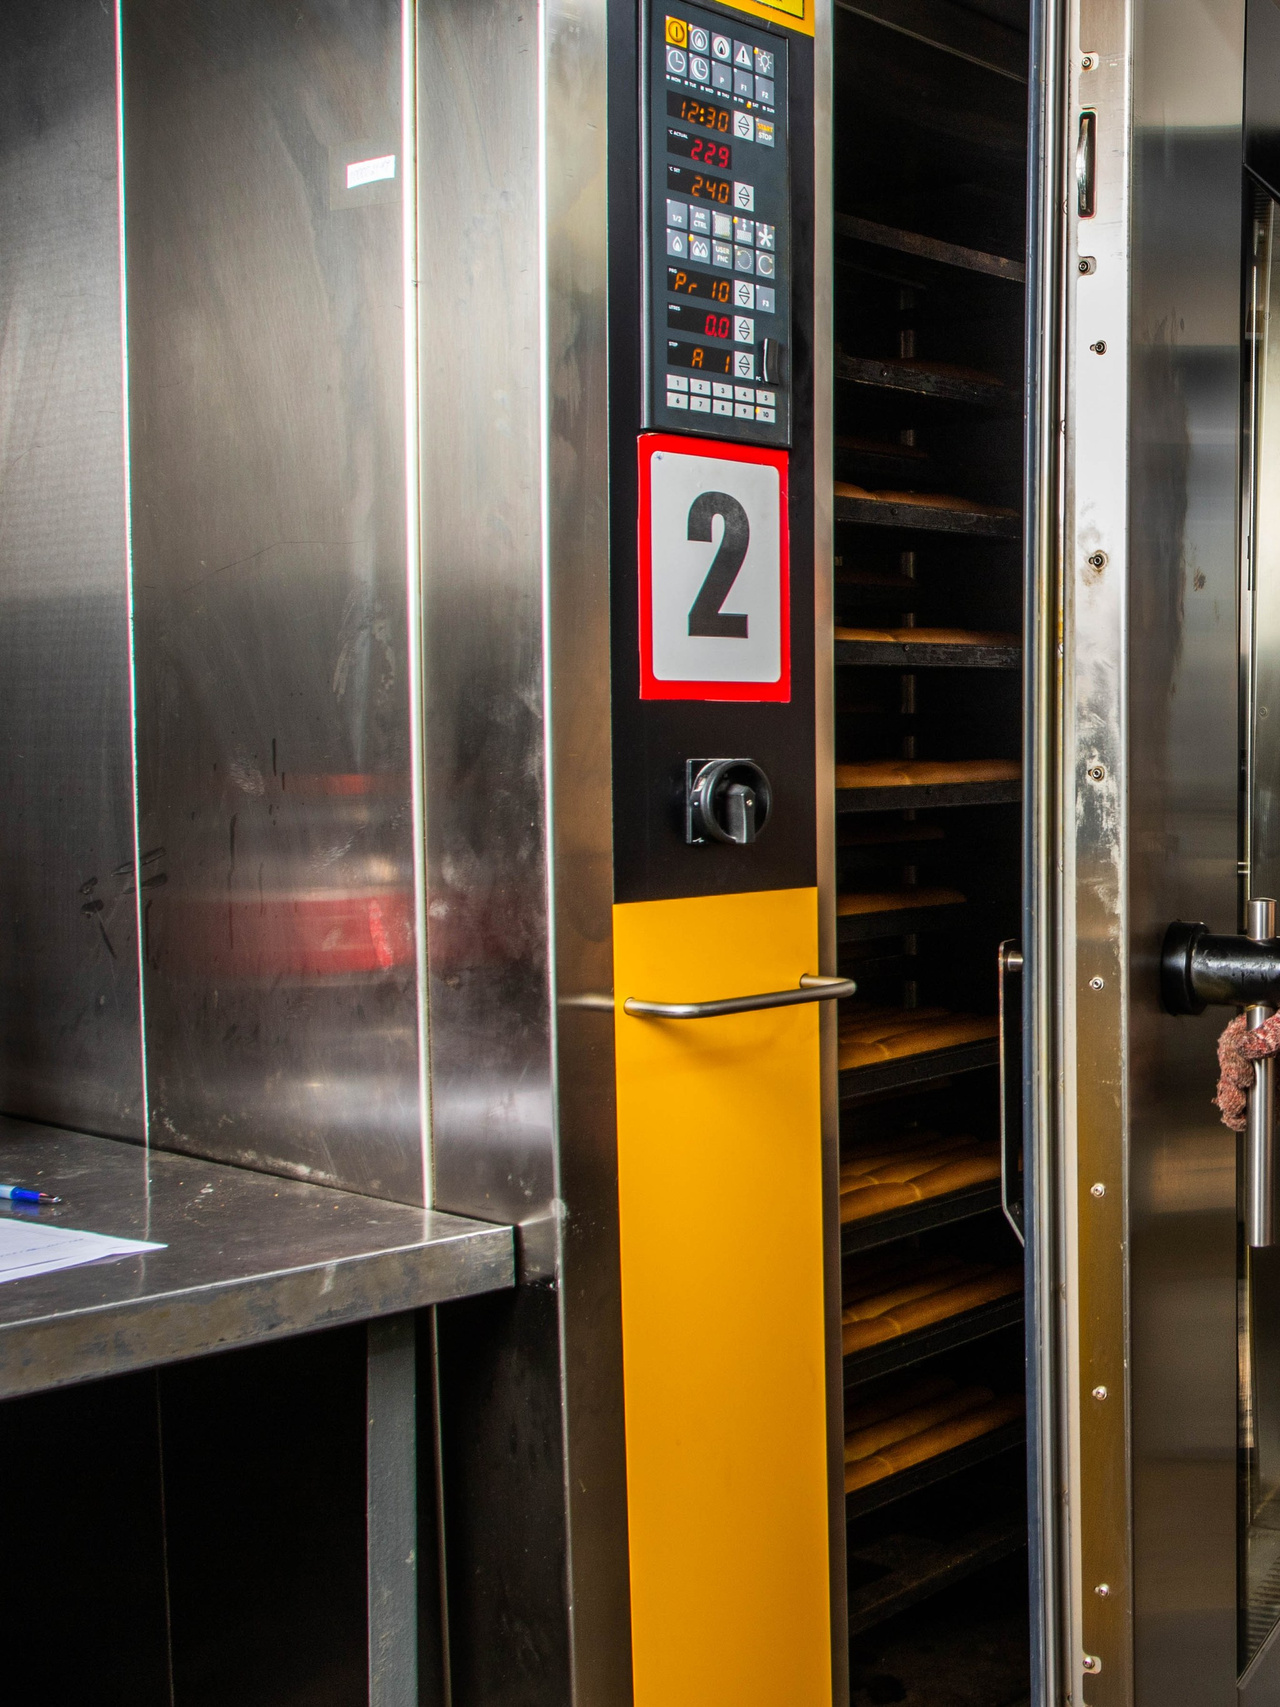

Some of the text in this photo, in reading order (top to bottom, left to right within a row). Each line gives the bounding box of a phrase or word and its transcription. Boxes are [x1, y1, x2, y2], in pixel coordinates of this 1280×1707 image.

[740, 83, 747, 91] F1
[761, 91, 769, 99] F2
[681, 100, 730, 133] 12:30
[757, 123, 773, 133] START
[673, 130, 689, 140] ACTUAL
[758, 132, 773, 141] STOP
[690, 139, 730, 169] 229
[691, 175, 730, 204] 240
[672, 214, 682, 223] 1/2
[695, 211, 705, 220] AIR
[693, 220, 707, 229] CTRL
[715, 246, 730, 255] USER
[717, 255, 729, 263] FNC
[674, 272, 730, 303] Pr 10
[762, 299, 770, 308] F3
[704, 314, 730, 339] 0.0
[691, 347, 704, 368] A
[686, 490, 751, 639] 2
